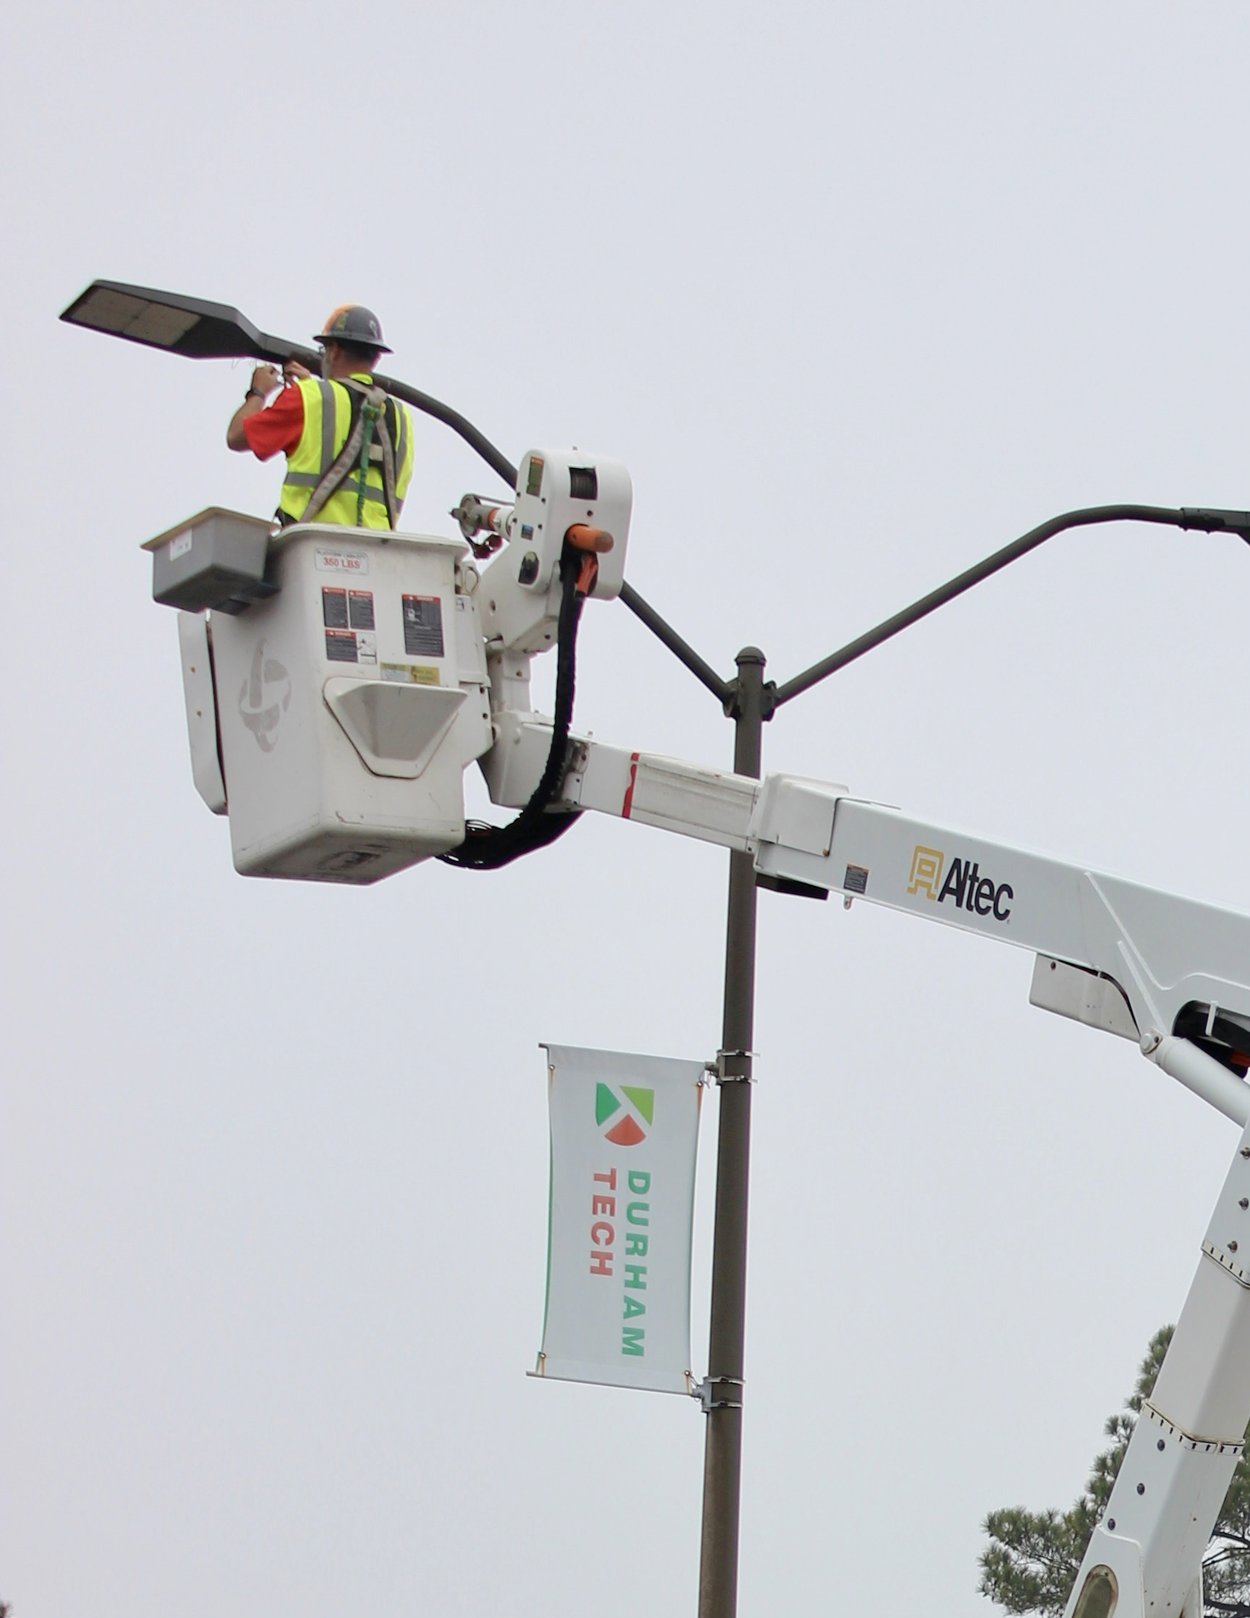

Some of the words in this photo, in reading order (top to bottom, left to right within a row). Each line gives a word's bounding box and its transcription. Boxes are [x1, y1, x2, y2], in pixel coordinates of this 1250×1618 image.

[937, 857, 1014, 921] Altec
[590, 1168, 617, 1276] TECH
[622, 1170, 651, 1356] DURHAM
